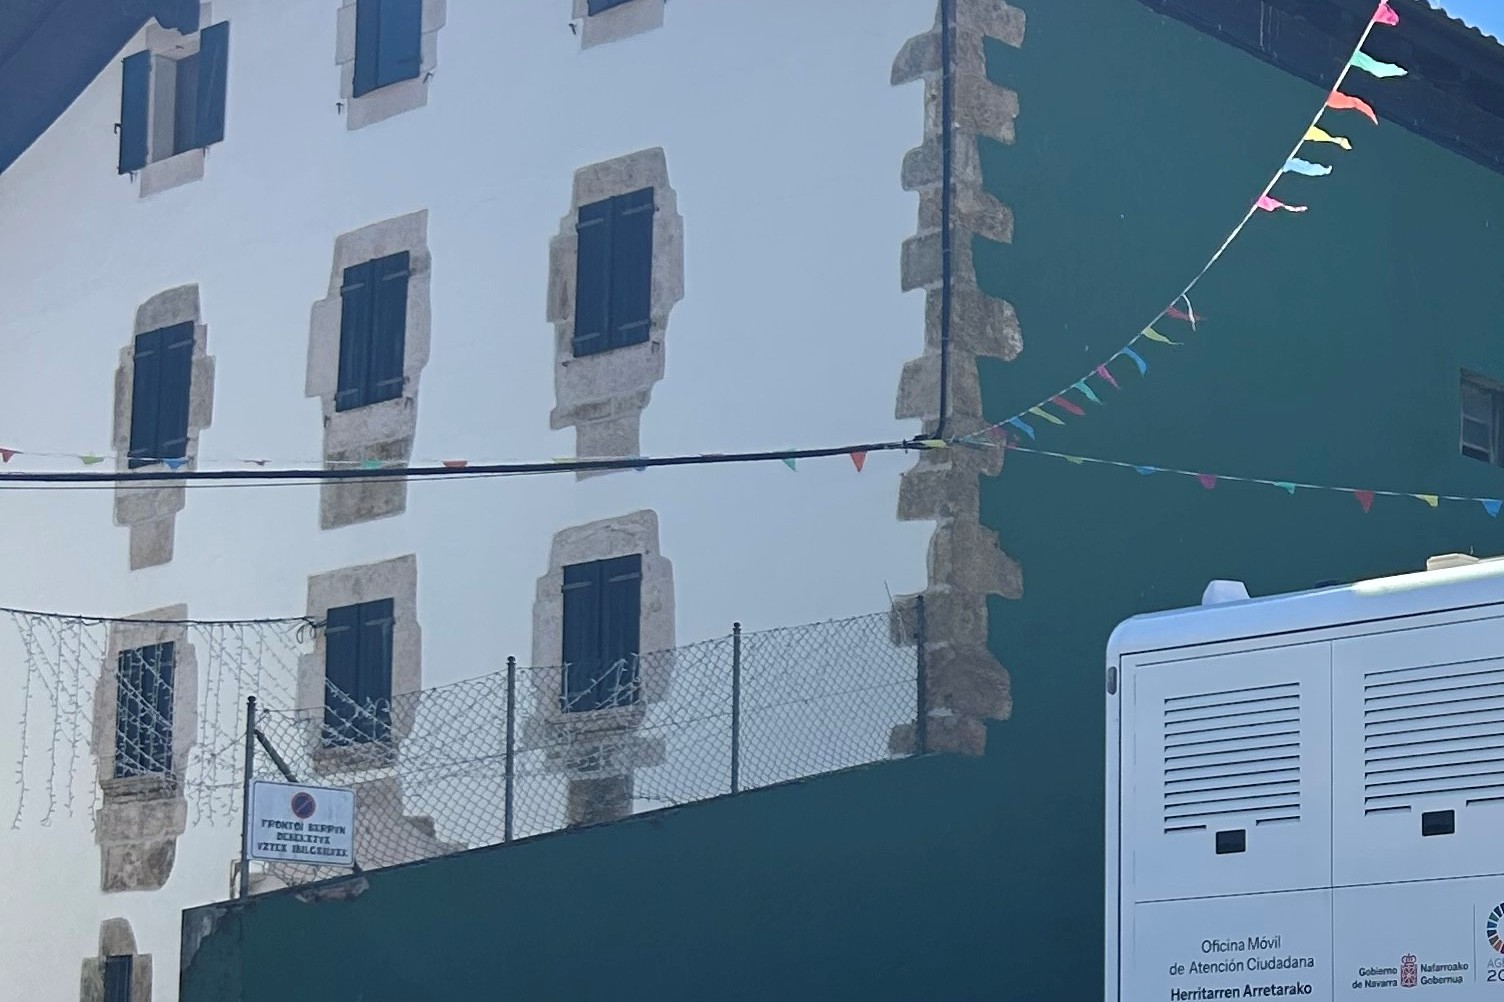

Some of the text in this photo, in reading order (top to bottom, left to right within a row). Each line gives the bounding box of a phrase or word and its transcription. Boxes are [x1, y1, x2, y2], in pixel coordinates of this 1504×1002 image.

[1201, 935, 1281, 953] Oficina Móvil
[1169, 955, 1314, 976] de Atención Ciudadana
[1421, 962, 1468, 973] Nafarroako
[1359, 967, 1397, 976] Gobierno
[1352, 979, 1398, 988] de Navarra
[1421, 975, 1463, 985] Gobernua
[1171, 982, 1312, 1001] Herritarren Arretarako
